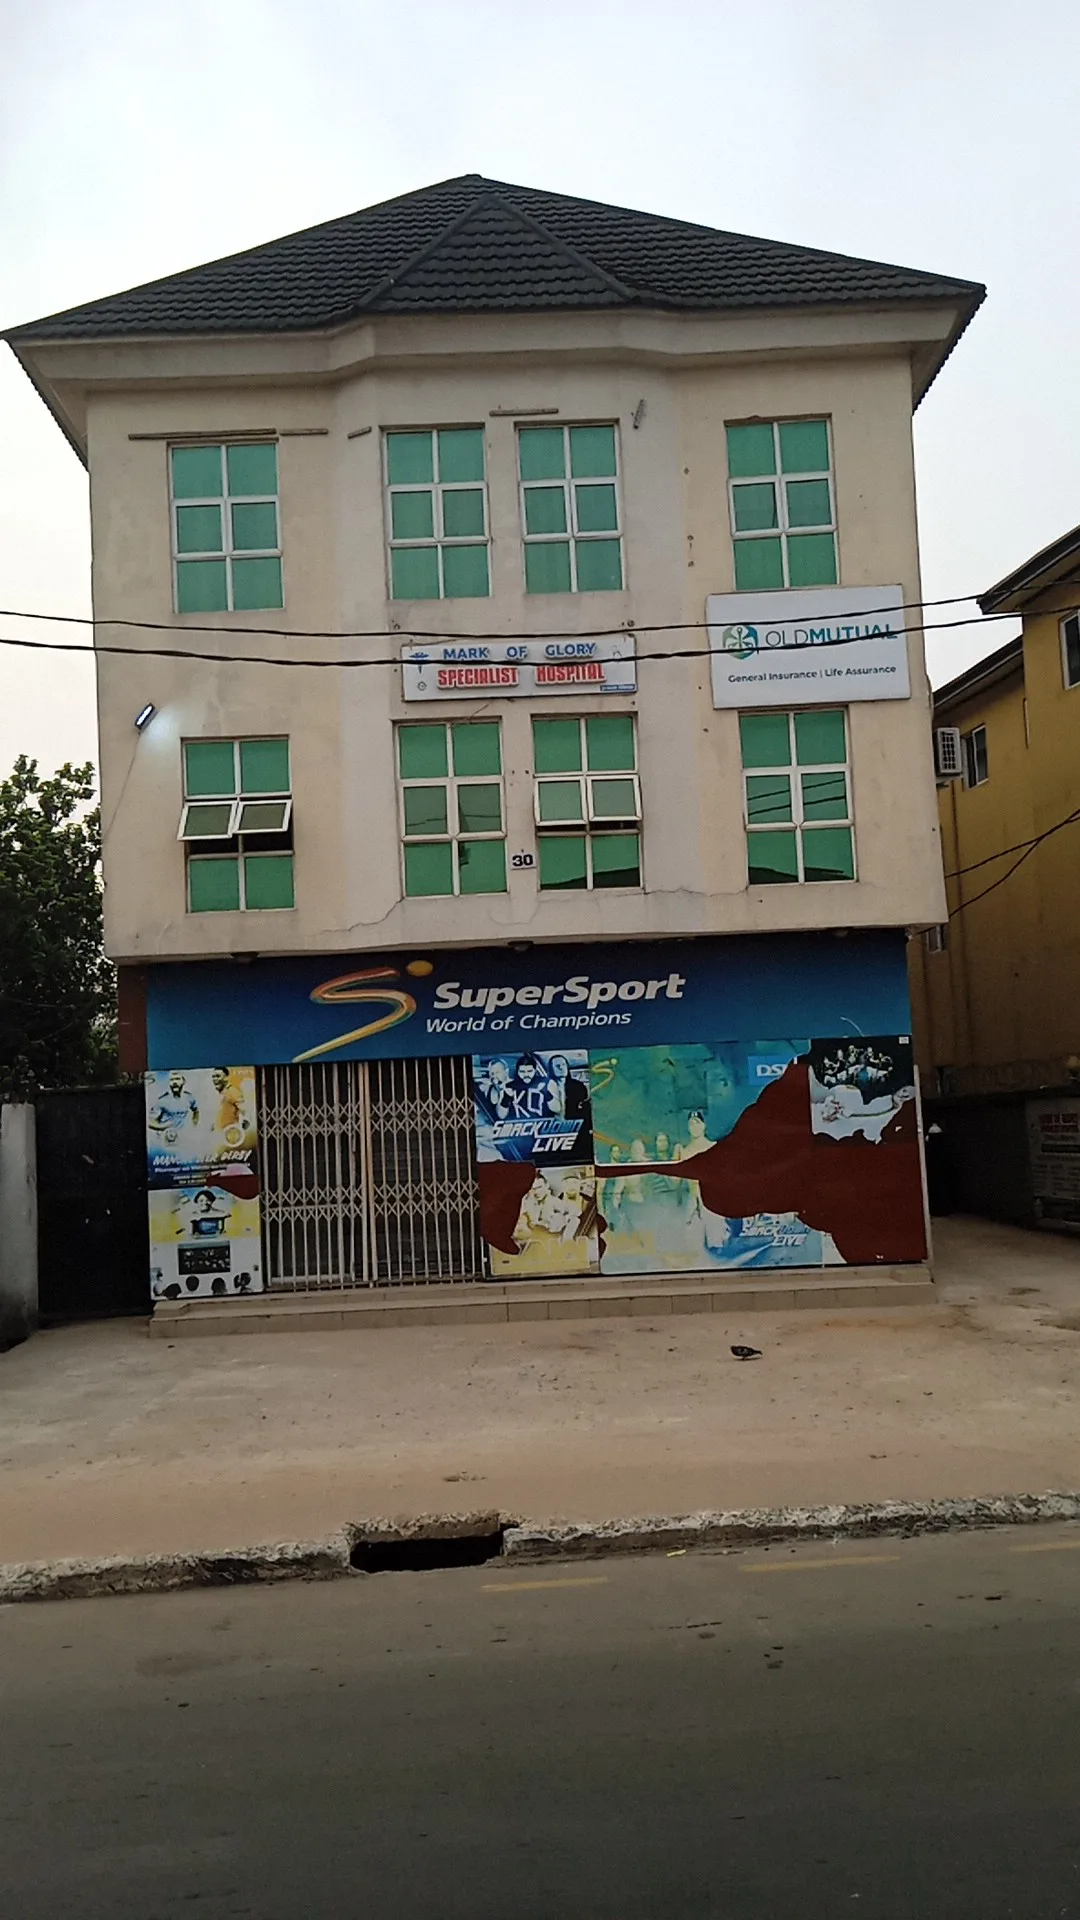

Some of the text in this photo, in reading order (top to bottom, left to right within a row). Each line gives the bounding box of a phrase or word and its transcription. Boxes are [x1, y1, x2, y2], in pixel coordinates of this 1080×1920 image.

[443, 643, 597, 660] MARK OF GLORY
[437, 663, 606, 686] SPECIALIST HOSPITAL
[728, 672, 767, 683] General
[769, 670, 818, 681] Insurance
[825, 668, 844, 678] Life
[844, 665, 897, 677] Assurance
[512, 854, 533, 866] 30
[433, 973, 686, 1014] SuperSport
[426, 1012, 632, 1033] World of Champions
[532, 1135, 577, 1153] LIVE
